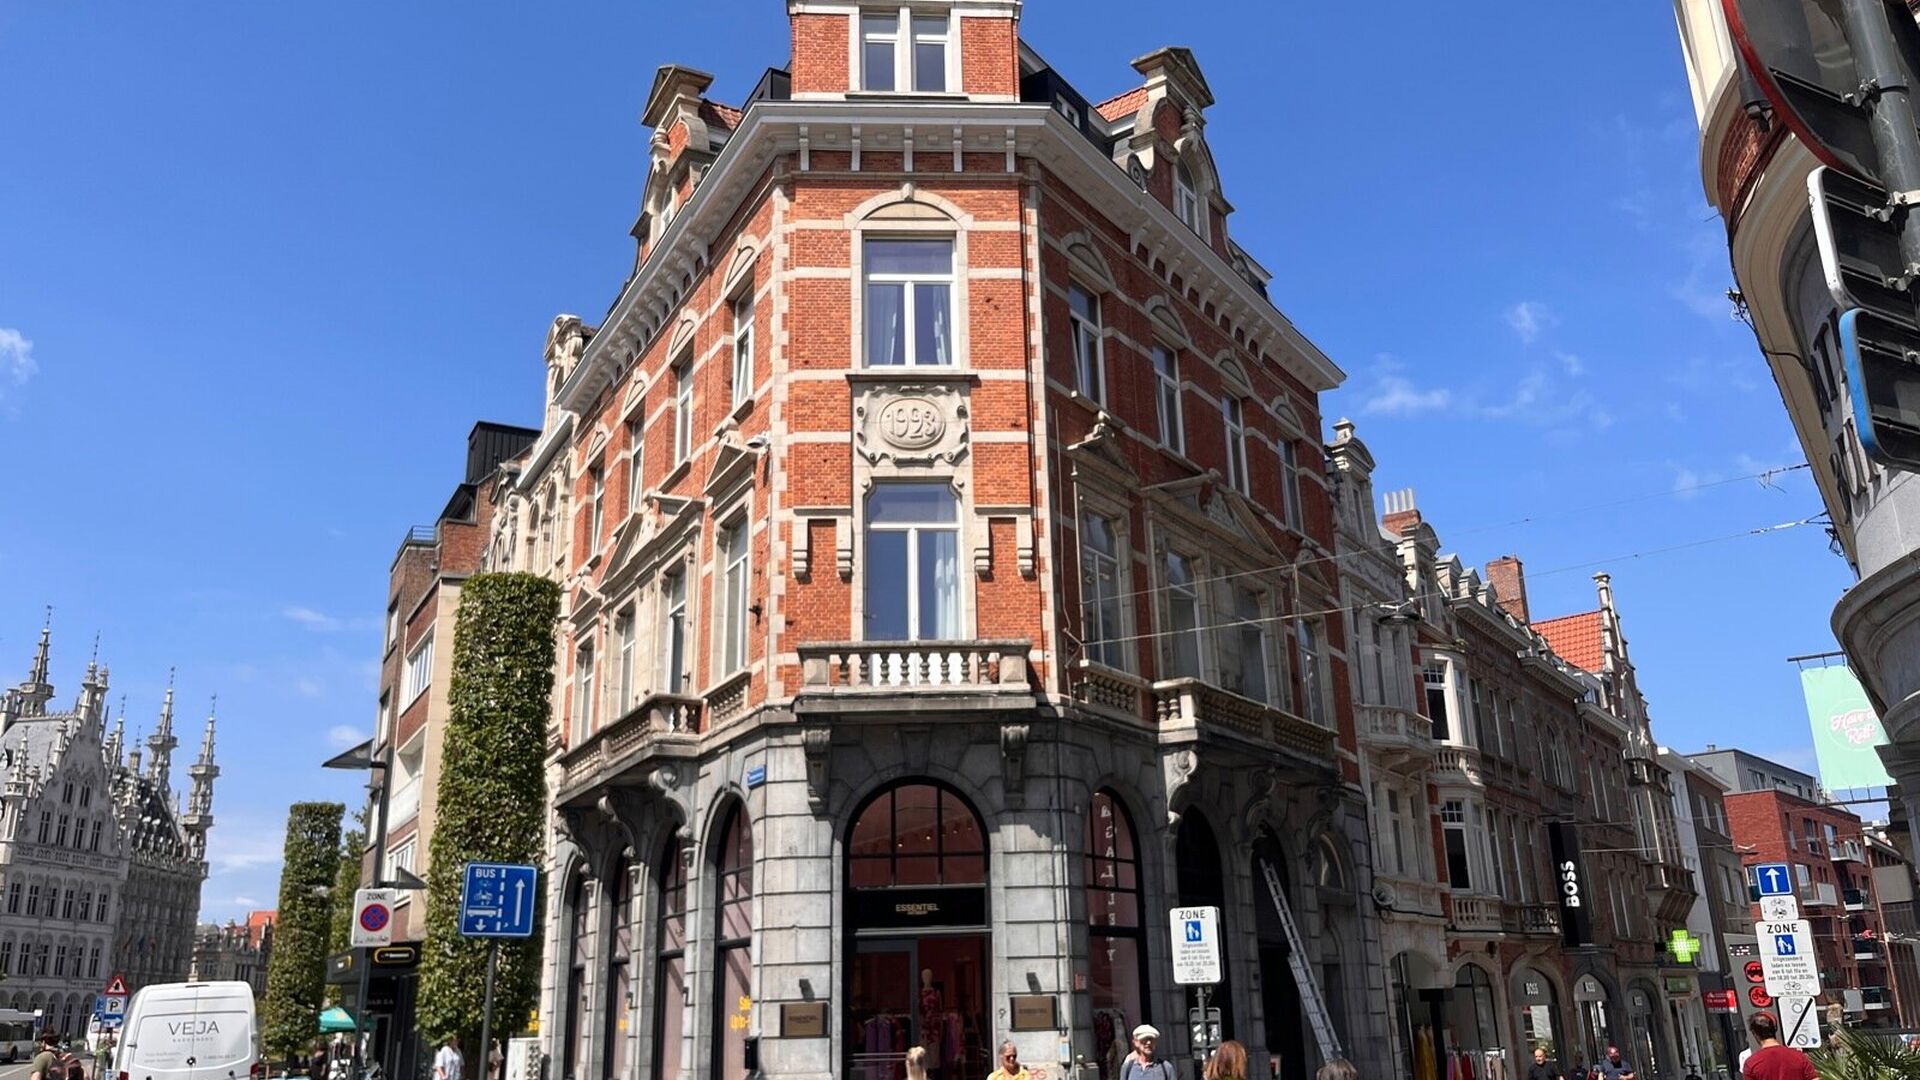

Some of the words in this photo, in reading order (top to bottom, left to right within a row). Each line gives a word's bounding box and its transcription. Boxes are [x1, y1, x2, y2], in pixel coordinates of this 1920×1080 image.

[475, 868, 496, 878] BUS
[1560, 860, 1580, 907] BOSS
[367, 892, 386, 901] ZONE
[895, 903, 940, 912] ESSENTIEL
[1179, 909, 1206, 920] ZONE
[1766, 923, 1799, 934] ZONE
[998, 1008, 1006, 1019] 9
[168, 1021, 220, 1036] VEJA
